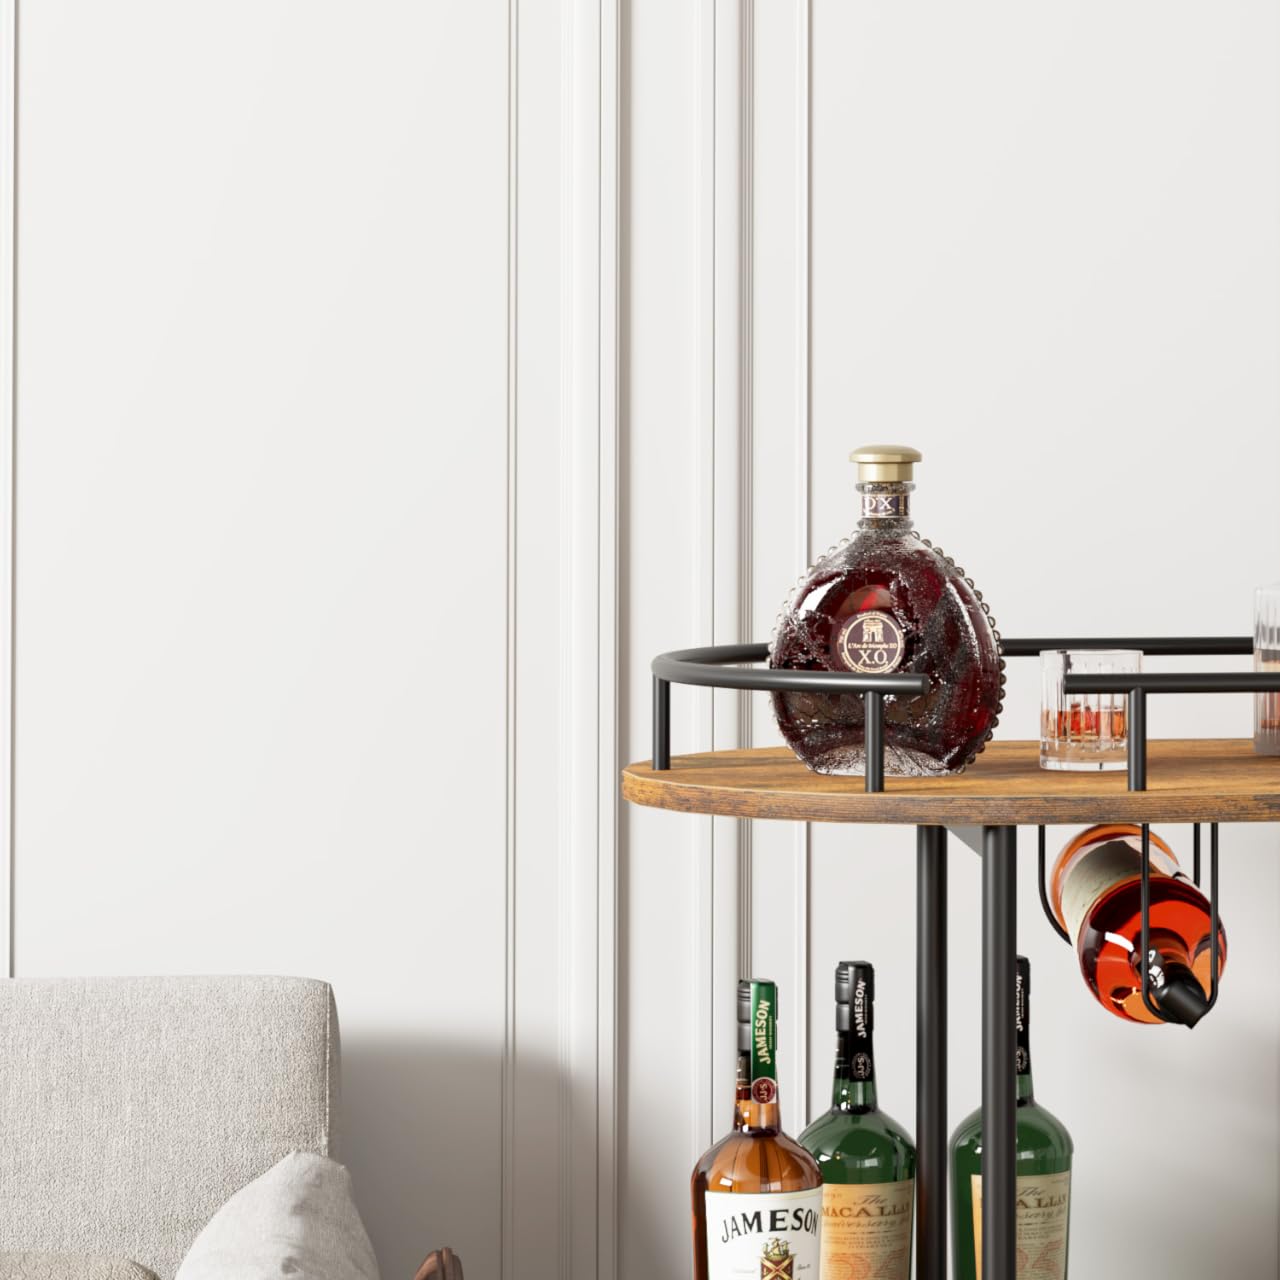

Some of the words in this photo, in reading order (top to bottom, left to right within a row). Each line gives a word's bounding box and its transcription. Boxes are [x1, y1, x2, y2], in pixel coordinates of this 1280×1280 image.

[755, 1000, 771, 1065] JAMESON
[854, 979, 867, 1038] JAMESON
[721, 1208, 819, 1243] JAMESON
